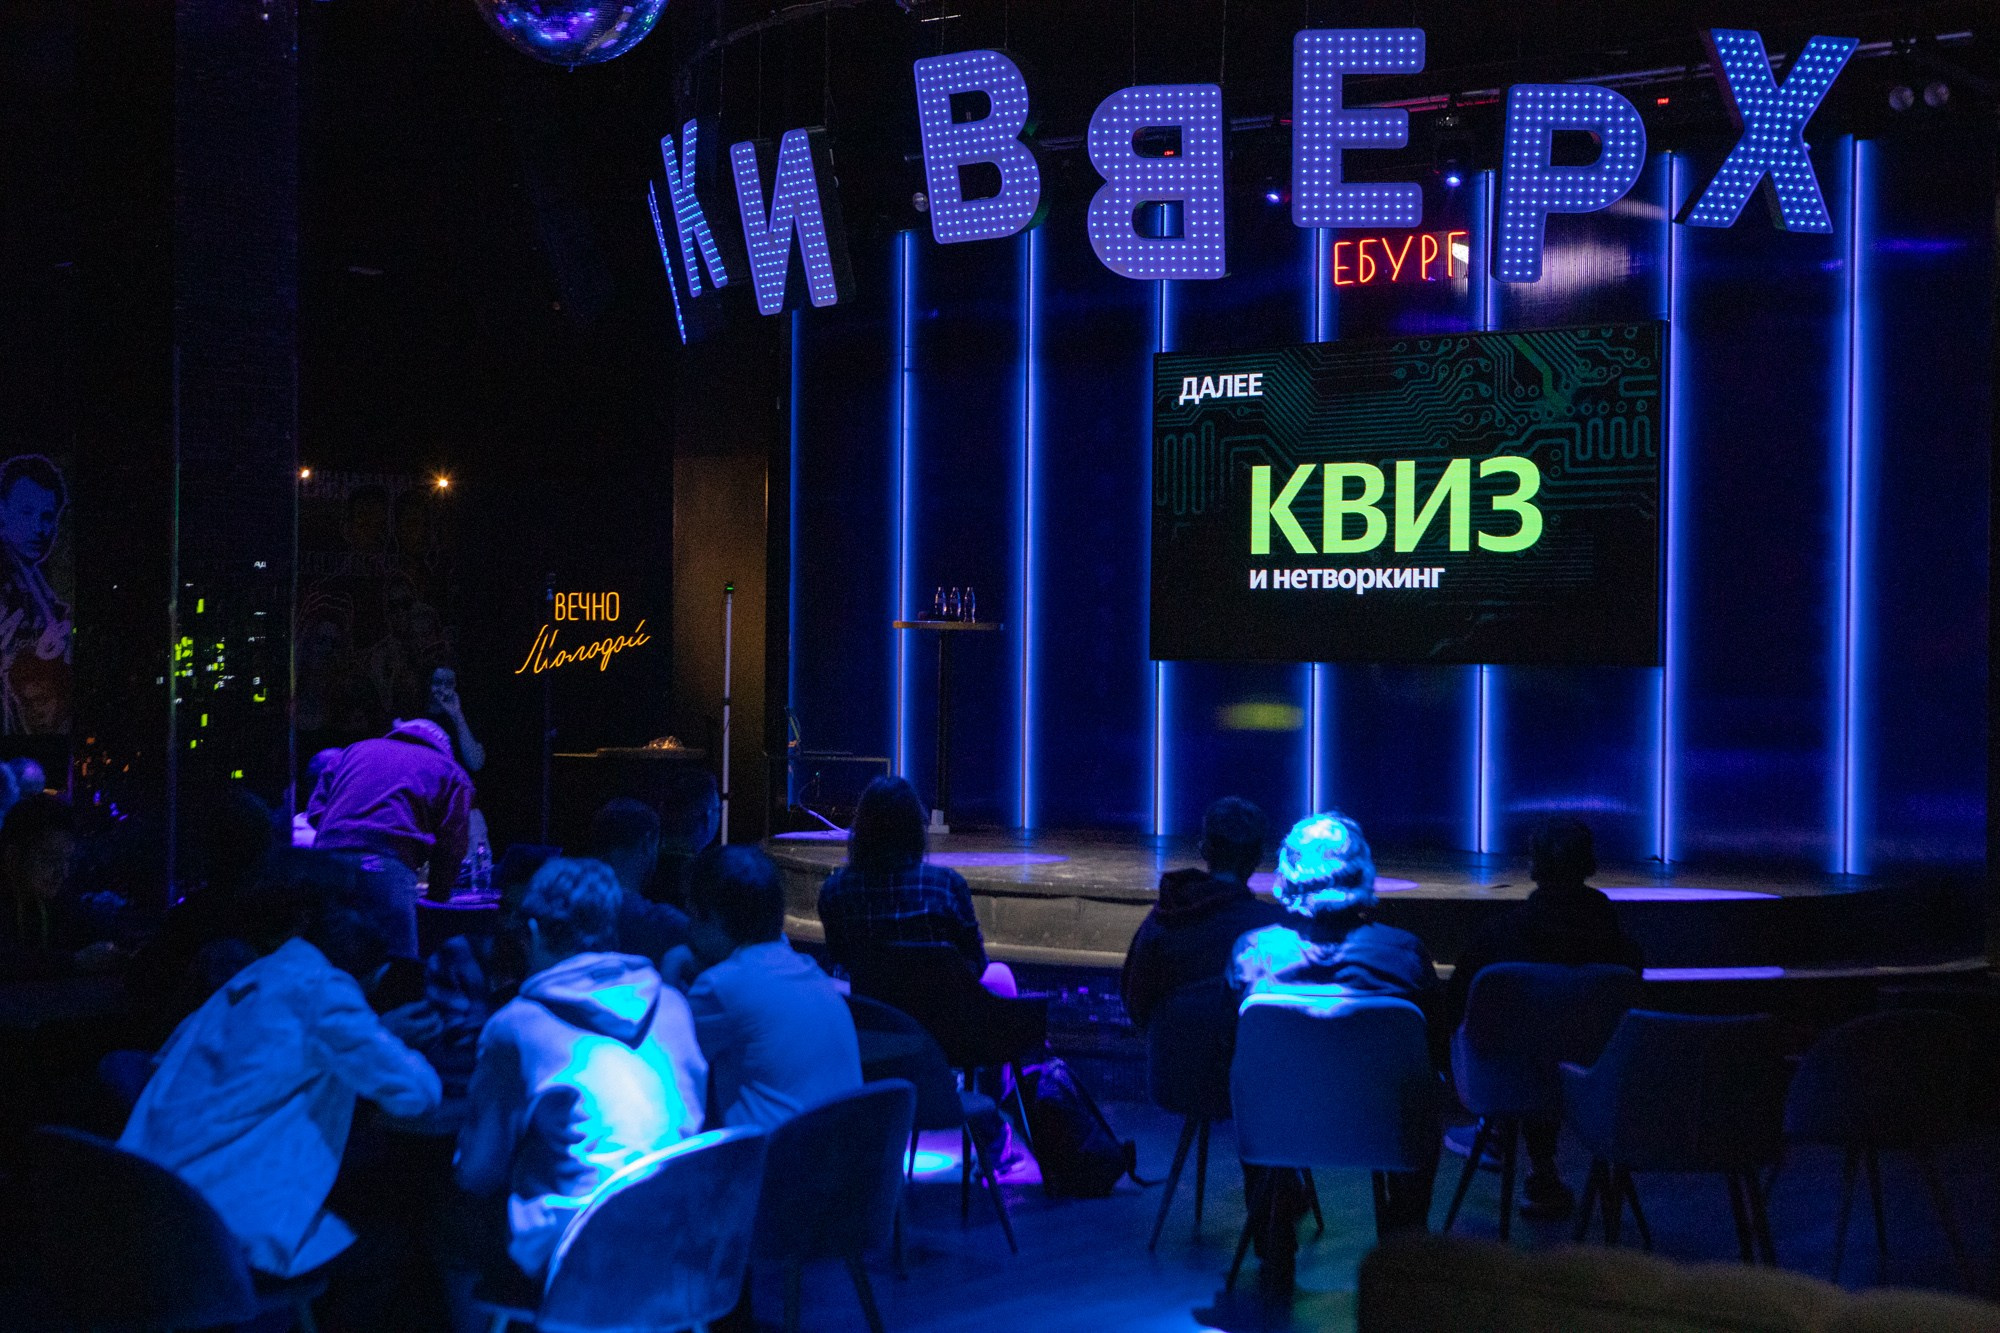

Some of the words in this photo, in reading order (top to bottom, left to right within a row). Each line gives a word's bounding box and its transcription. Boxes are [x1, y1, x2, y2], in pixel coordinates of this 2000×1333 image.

[1334, 230, 1467, 285] ЕБУРГ
[1179, 373, 1263, 405] ДАЛЕЕ
[1250, 456, 1543, 555] КВИЗ
[1249, 569, 1267, 589] и
[1273, 566, 1445, 595] нетворкинг
[554, 591, 620, 622] ВЕЧНО
